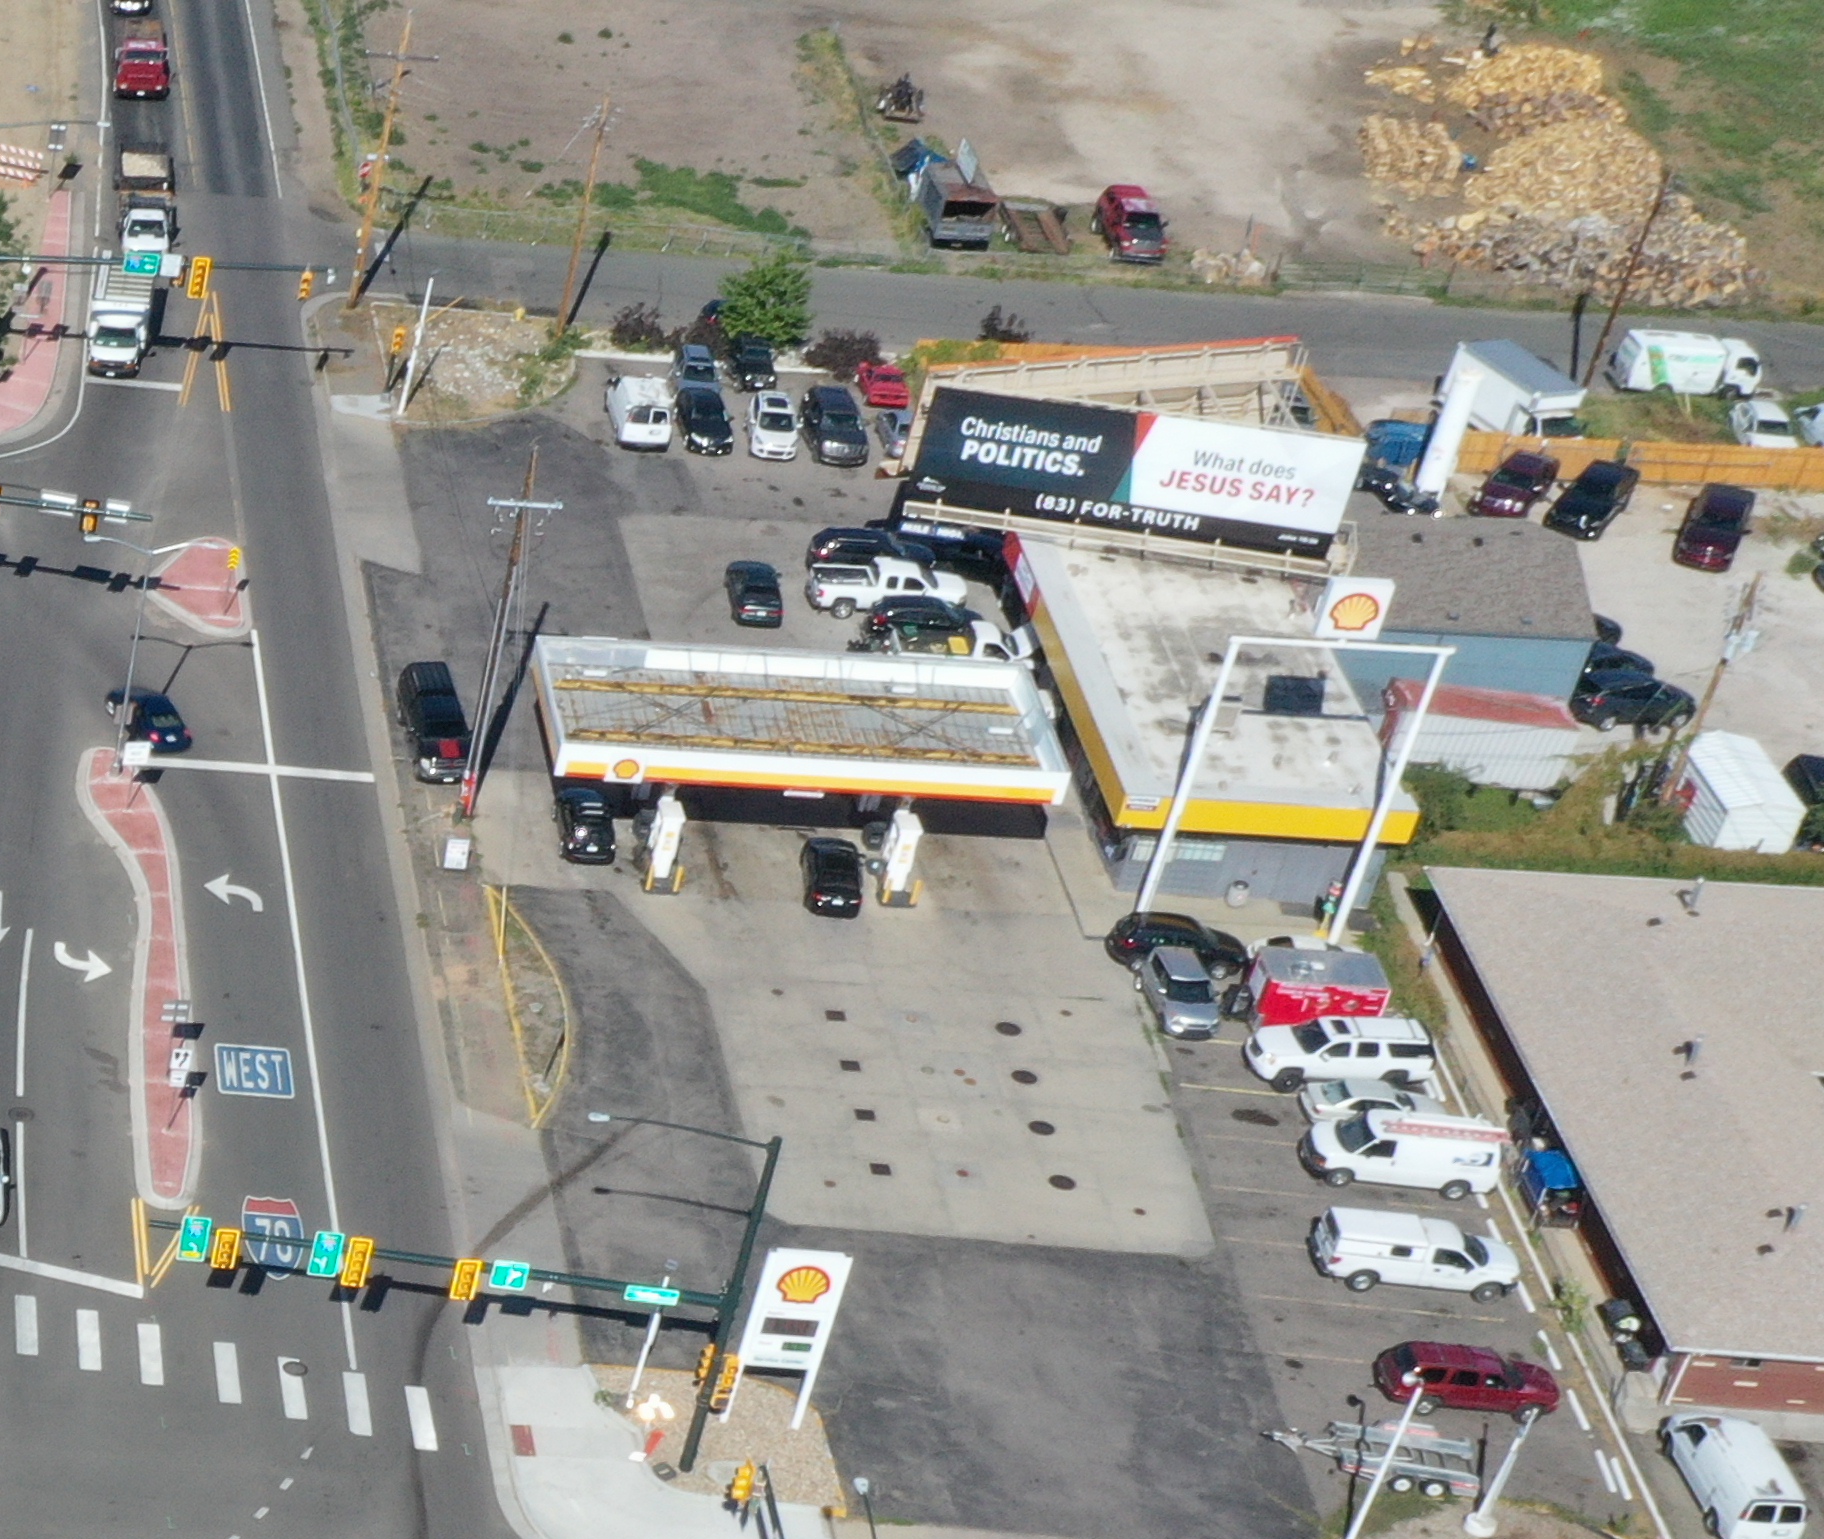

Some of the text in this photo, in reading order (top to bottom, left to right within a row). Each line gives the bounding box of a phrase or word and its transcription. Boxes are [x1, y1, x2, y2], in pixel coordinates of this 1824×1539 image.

[960, 416, 1104, 454] Christians and
[960, 438, 1085, 477] POLITICS.
[1193, 449, 1297, 481] What does
[1158, 469, 1316, 508] JESUS SAY?
[1035, 493, 1201, 532] (83) FOR-TRUTH
[222, 1050, 284, 1092] WEST
[255, 1217, 293, 1263] 70
